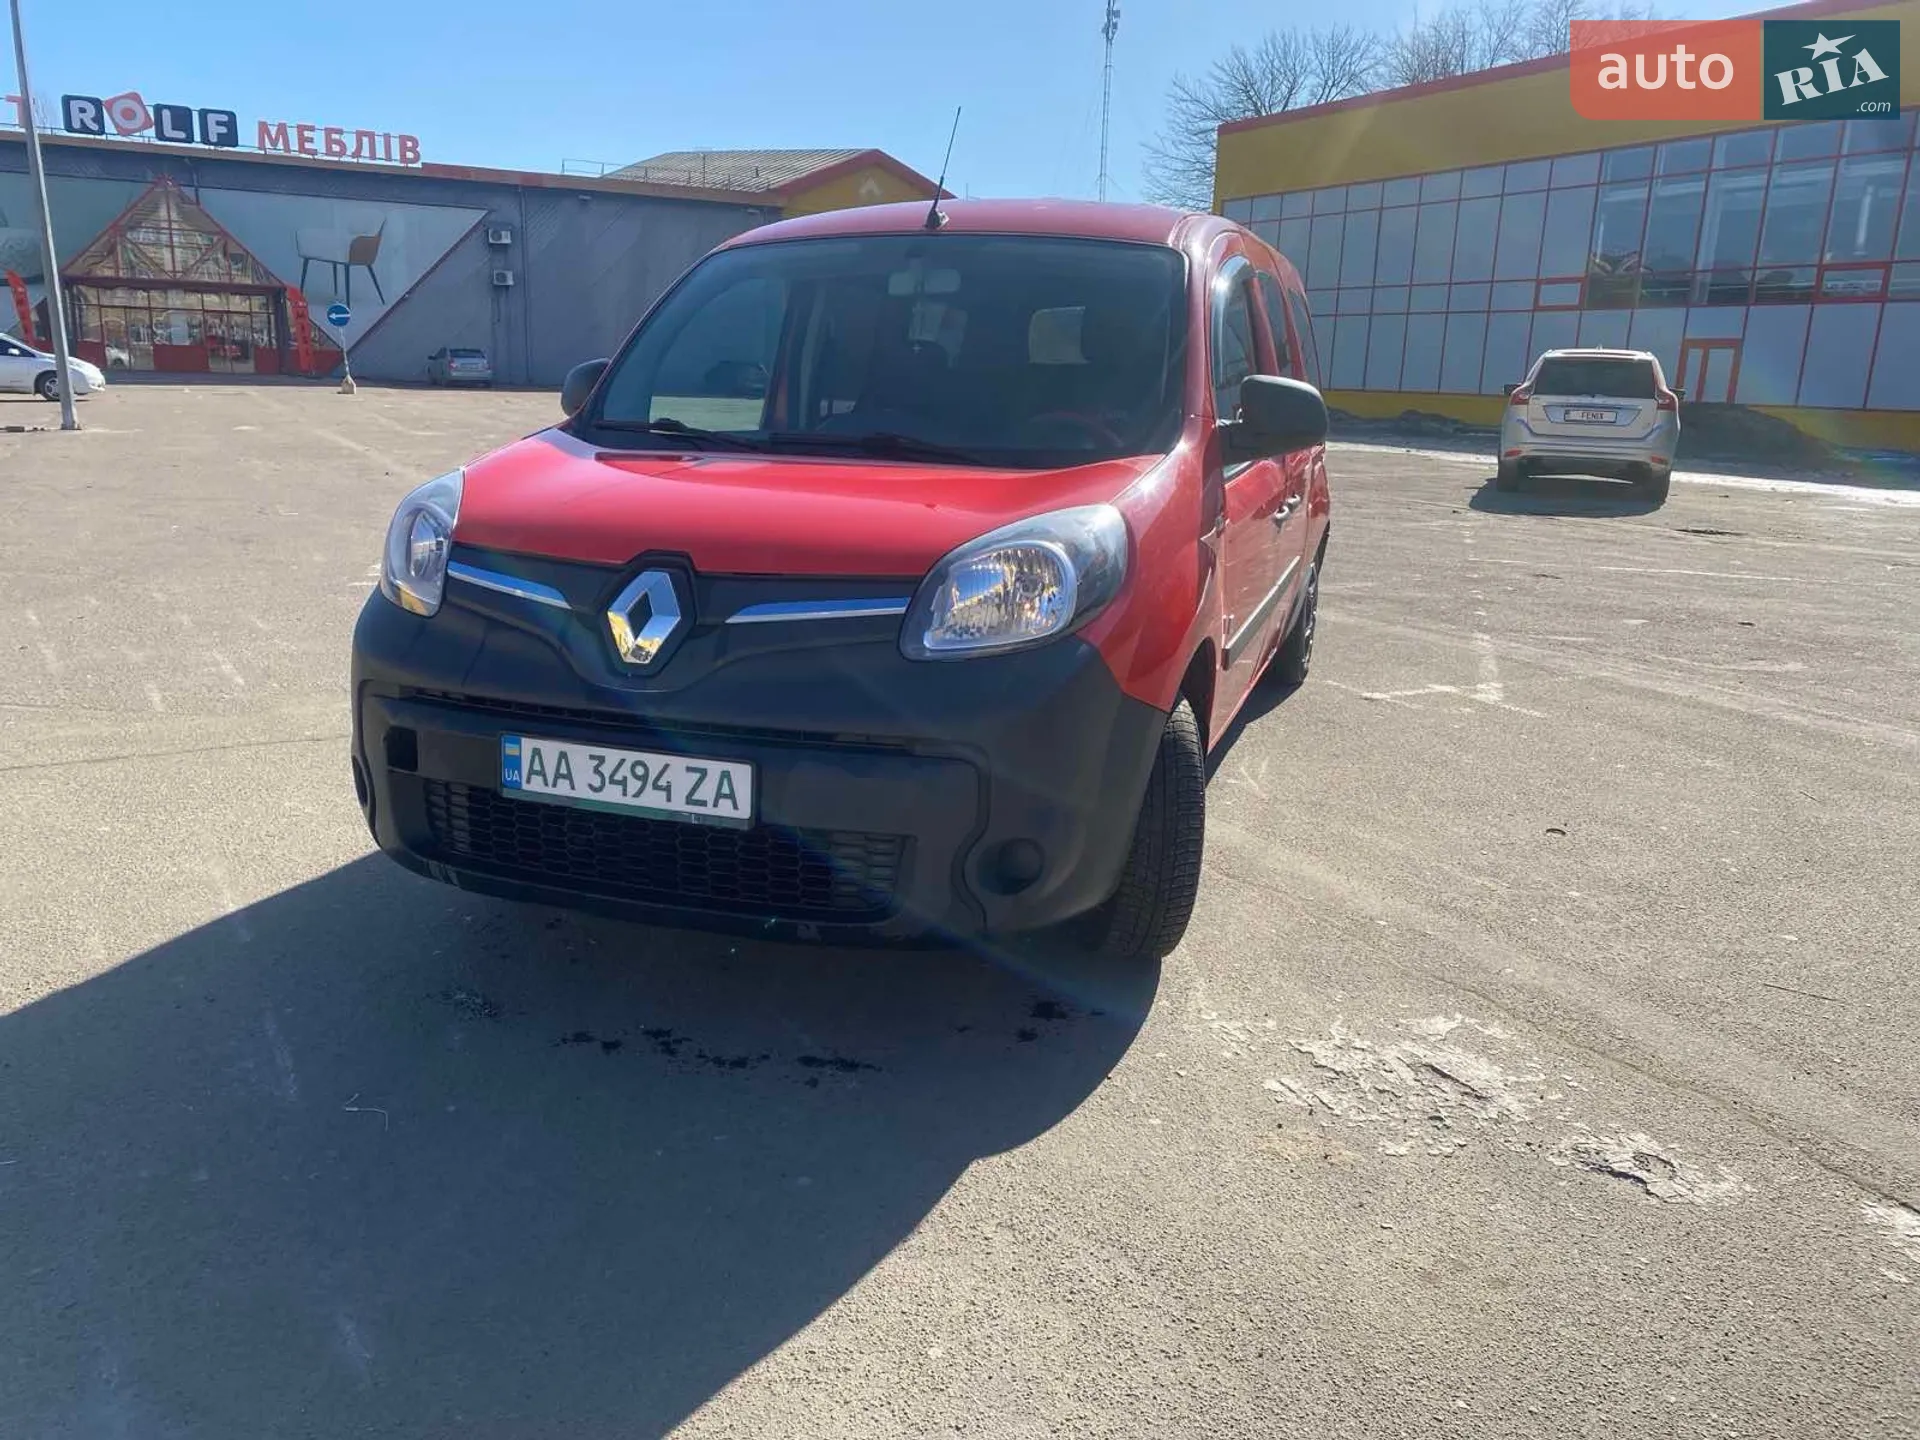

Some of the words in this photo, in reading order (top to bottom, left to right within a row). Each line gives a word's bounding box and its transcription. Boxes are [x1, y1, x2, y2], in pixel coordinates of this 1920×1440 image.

[66, 97, 231, 144] ROLF
[257, 120, 421, 164] МЕБЛІВ
[504, 768, 520, 782] UA
[525, 747, 575, 790] AA
[587, 754, 672, 803] 3494
[685, 766, 739, 811] ZA
